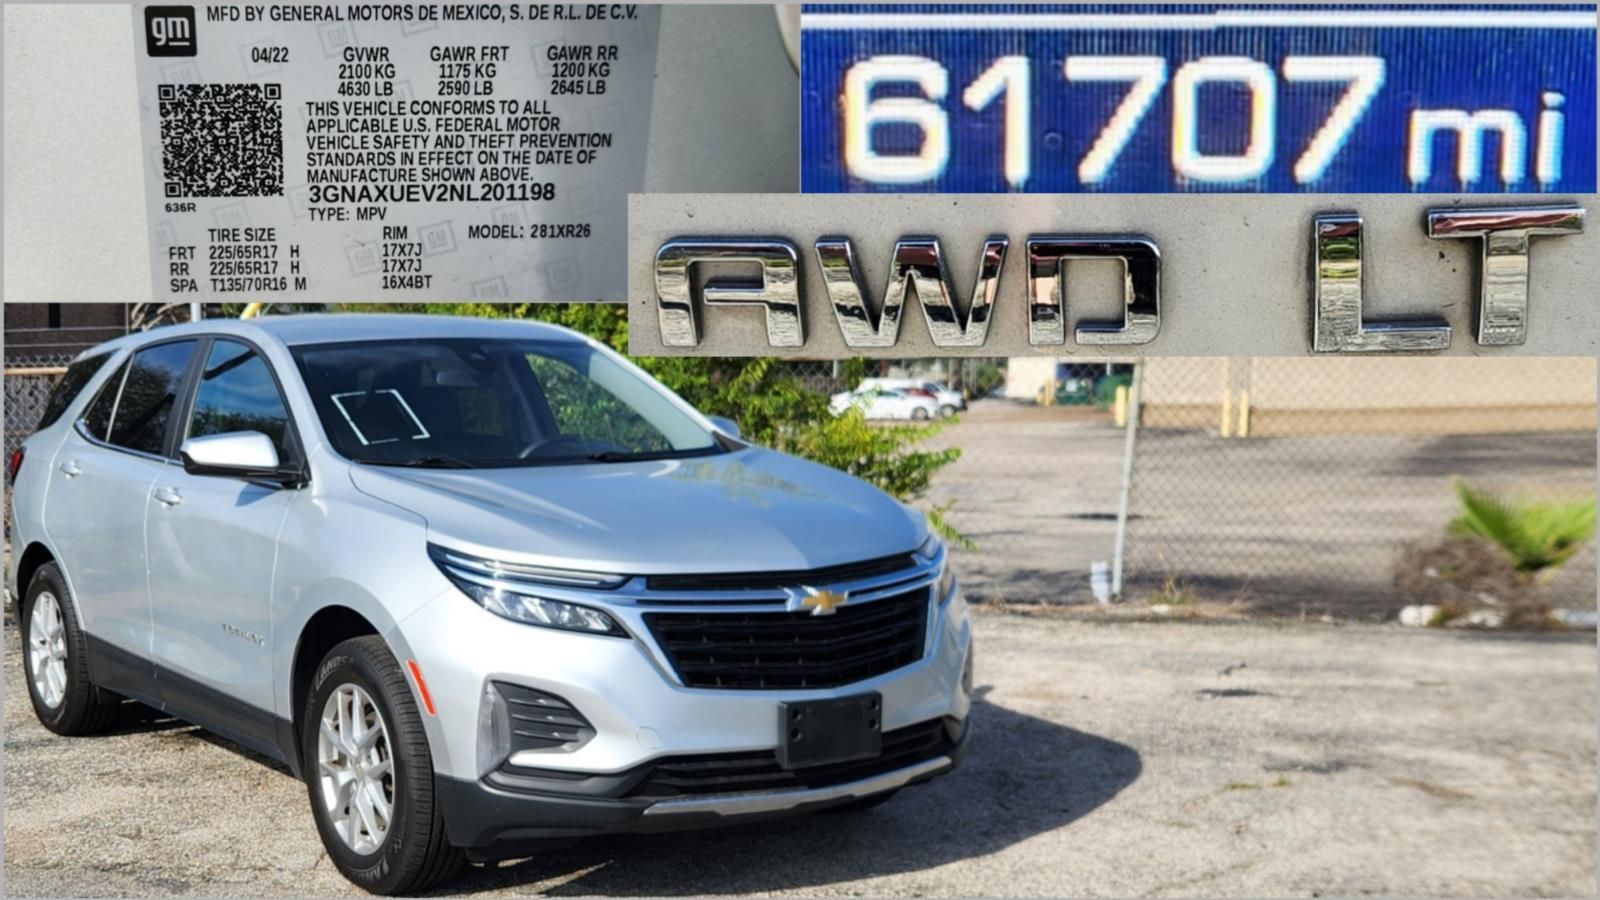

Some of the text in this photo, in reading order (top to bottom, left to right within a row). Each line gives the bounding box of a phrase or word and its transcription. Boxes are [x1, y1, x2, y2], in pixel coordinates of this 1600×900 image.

[207, 4, 638, 23] MFD BY GENERAL MOTORS DE MEXICO, S. DE R.L. DE C.V.
[151, 16, 191, 46] gm
[252, 47, 289, 63] 04/22
[343, 47, 389, 62] GVWR
[430, 46, 510, 61] GAWR FRT
[547, 45, 618, 61] GAWR RR
[339, 63, 396, 79] 2100 KG
[439, 63, 496, 78] 1175 KG
[552, 62, 610, 77] 1200 KG
[338, 81, 393, 96] 4630 LB
[438, 80, 493, 95] 2590 LB
[551, 80, 606, 95] 2645 LB
[305, 100, 551, 116] THIS VEHICLE CONFORMS TO ALL
[307, 117, 560, 133] APPLICABLE U.S. FEDERAL MOTOR
[842, 55, 1566, 186] 61707 mi
[307, 133, 612, 150] VEHICLE SAFETY AND THEFT PREVENTION
[307, 150, 597, 166] STANDARDS IN EFFECT ON THE DATE OF
[307, 167, 534, 183] MANUFACTURE SHOWN ABOVE.
[309, 183, 555, 203] 3GNAXUEV2NL201198
[165, 203, 197, 213] 636R
[308, 207, 387, 221] TYPE: MPV
[208, 228, 276, 242] TIRE SIZE
[382, 226, 408, 240] RIM
[468, 224, 591, 239] MODEL: 281XR26
[169, 245, 300, 260] FRT 225/65R17 H
[382, 243, 423, 257] 17X7J
[170, 261, 300, 276] RR 225/65R17 H
[382, 259, 422, 272] 17X7J
[171, 277, 307, 292] SPA T135/70R16 M
[382, 275, 432, 289] 16X4BT
[654, 204, 1587, 351] AWD LT
